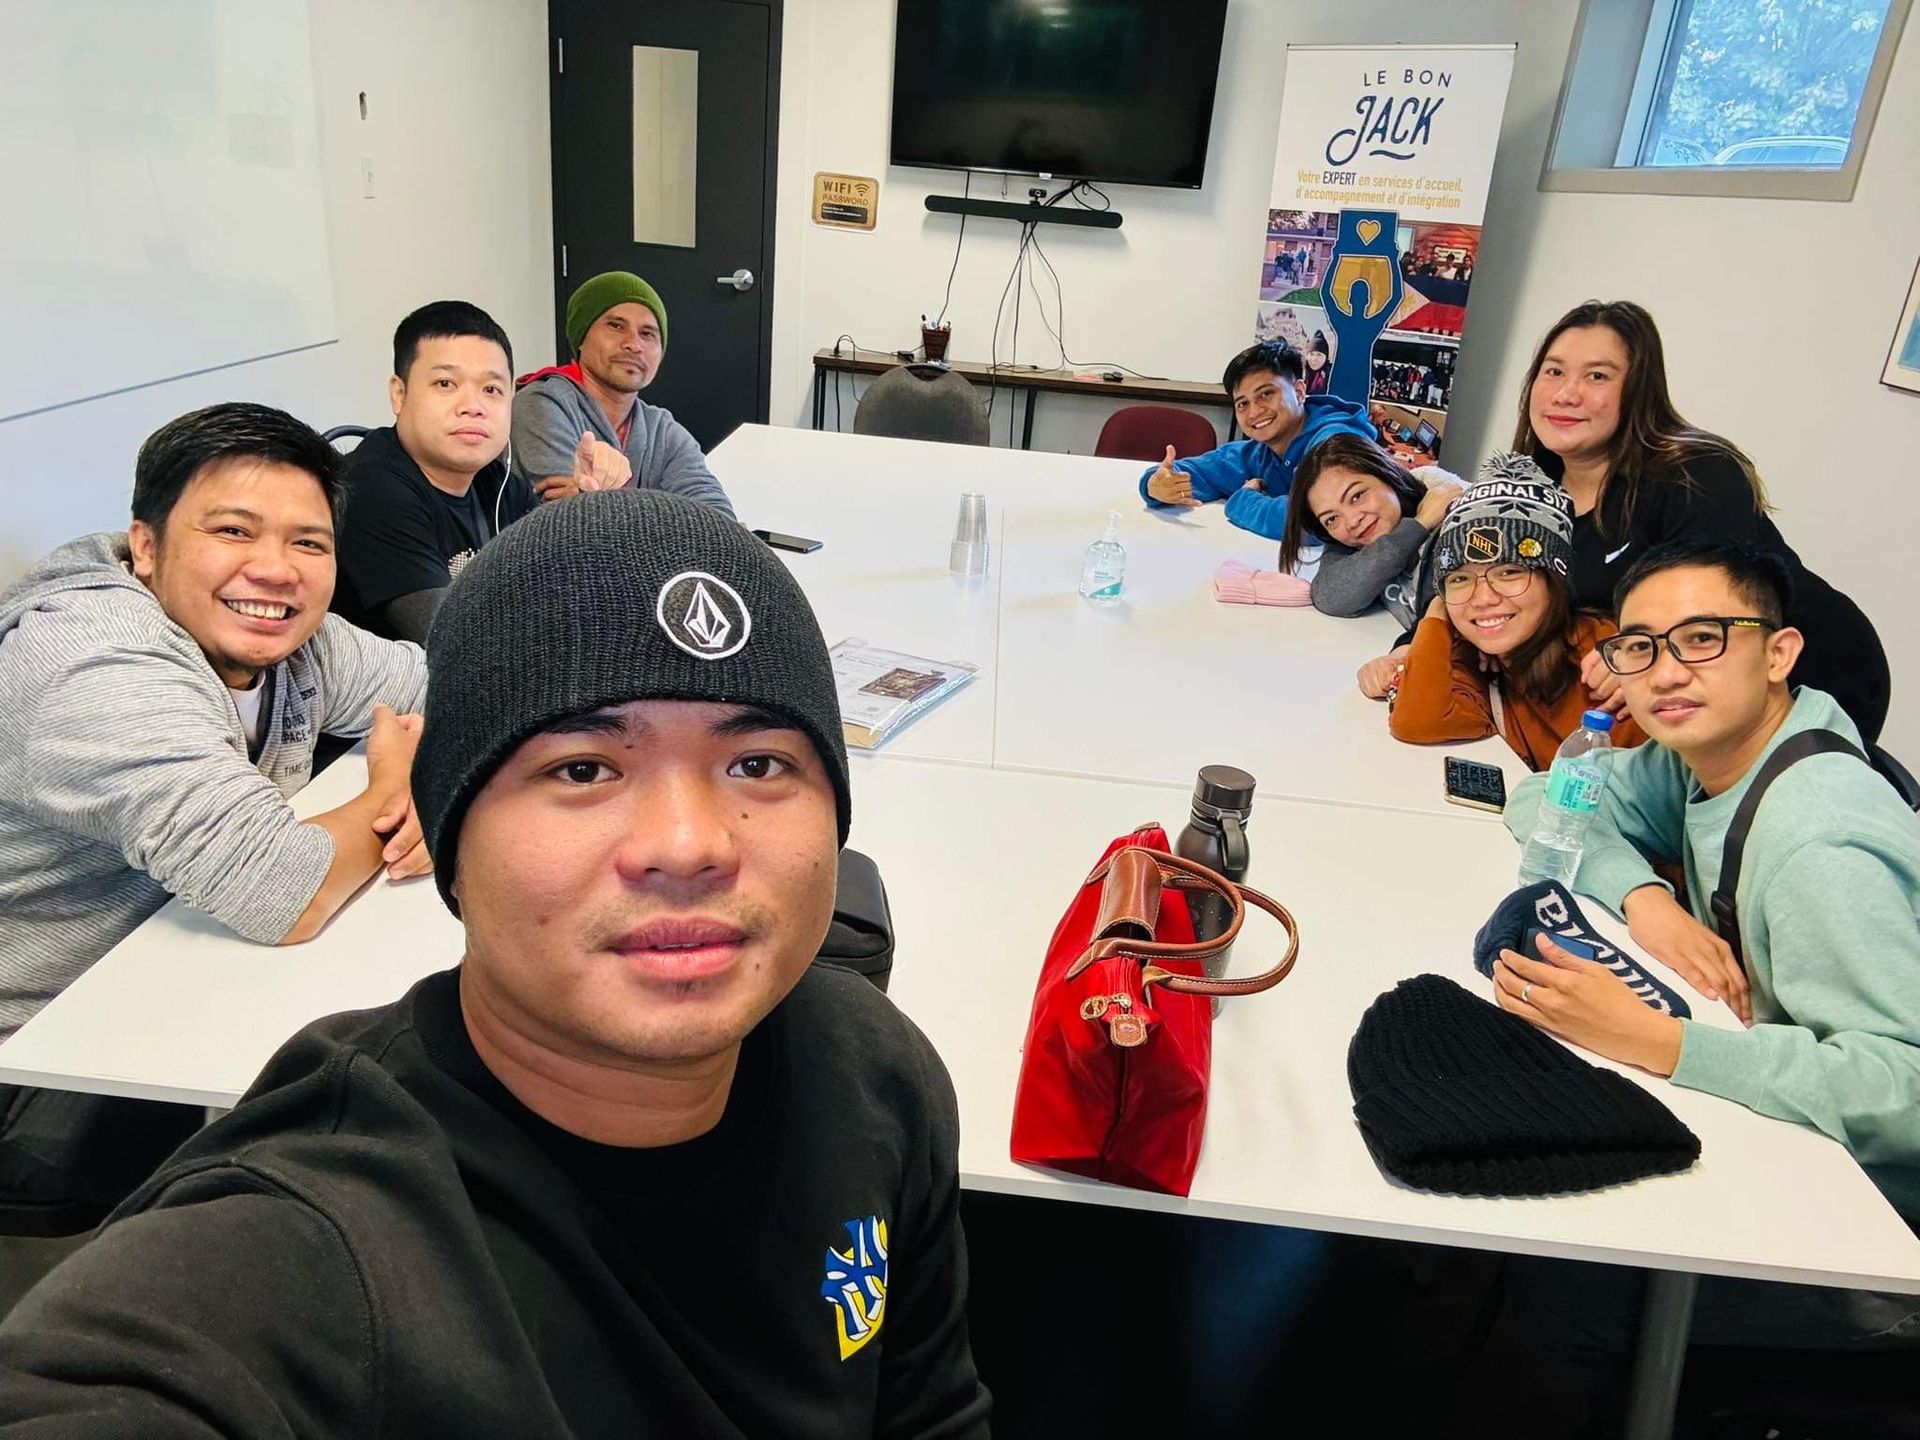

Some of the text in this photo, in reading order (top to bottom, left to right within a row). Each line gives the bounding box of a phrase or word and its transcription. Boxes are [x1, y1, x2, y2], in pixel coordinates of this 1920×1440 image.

[1363, 69, 1452, 88] LE BON
[1325, 95, 1445, 167] JACK
[823, 181, 852, 195] WIFI
[1297, 169, 1321, 184] Votre
[1322, 171, 1357, 186] EXPERT
[1358, 175, 1371, 186] en
[1373, 174, 1413, 189] services
[822, 194, 869, 207] PASSWORD
[1295, 185, 1386, 204] d'accompagnement
[1387, 192, 1397, 204] et
[1543, 489, 1569, 513] SIX
[1472, 535, 1495, 556] NHL
